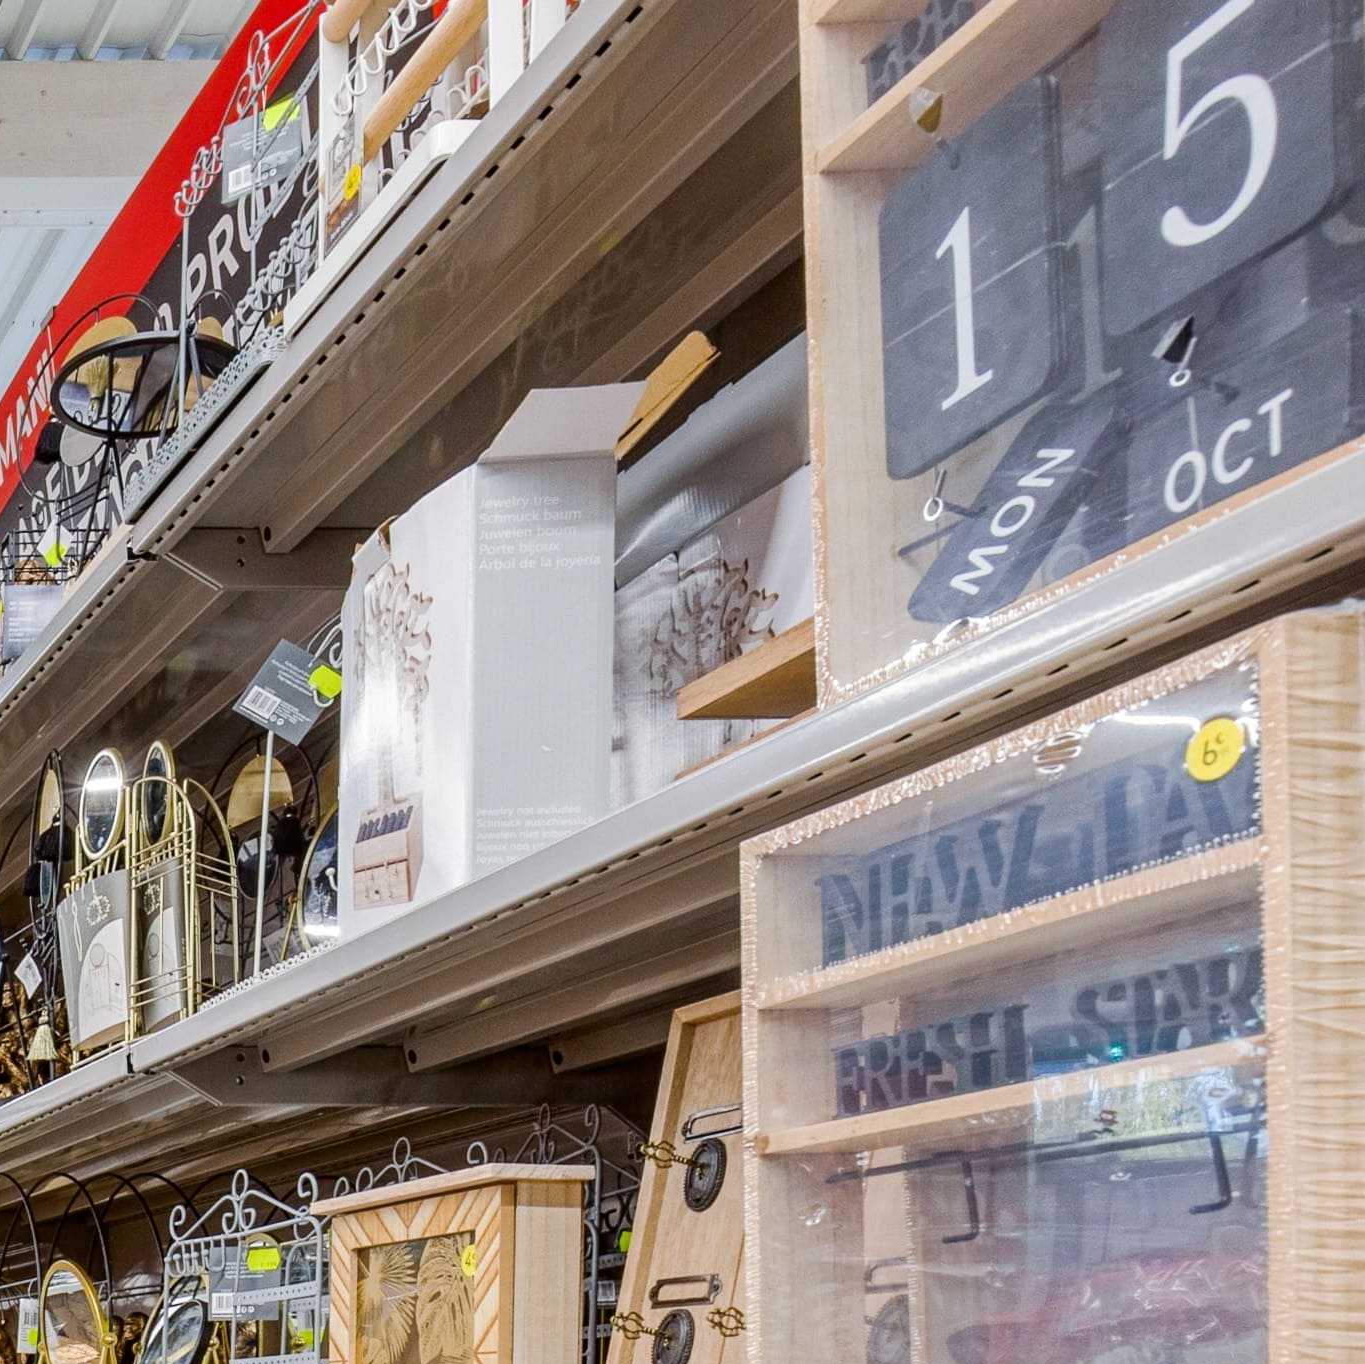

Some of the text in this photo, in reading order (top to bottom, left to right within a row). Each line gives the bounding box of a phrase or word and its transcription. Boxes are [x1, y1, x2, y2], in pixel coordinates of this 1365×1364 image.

[934, 206, 993, 411] 1
[1160, 0, 1278, 248] 5
[1164, 388, 1293, 514] OCT
[479, 496, 559, 510] Jewelry tree
[479, 509, 582, 524] Schmuck baum
[951, 447, 1076, 597] MON
[479, 526, 578, 540] Juwelen boom
[479, 542, 560, 555] Porte bijoux
[519, 558, 536, 569] de
[541, 557, 552, 568] la
